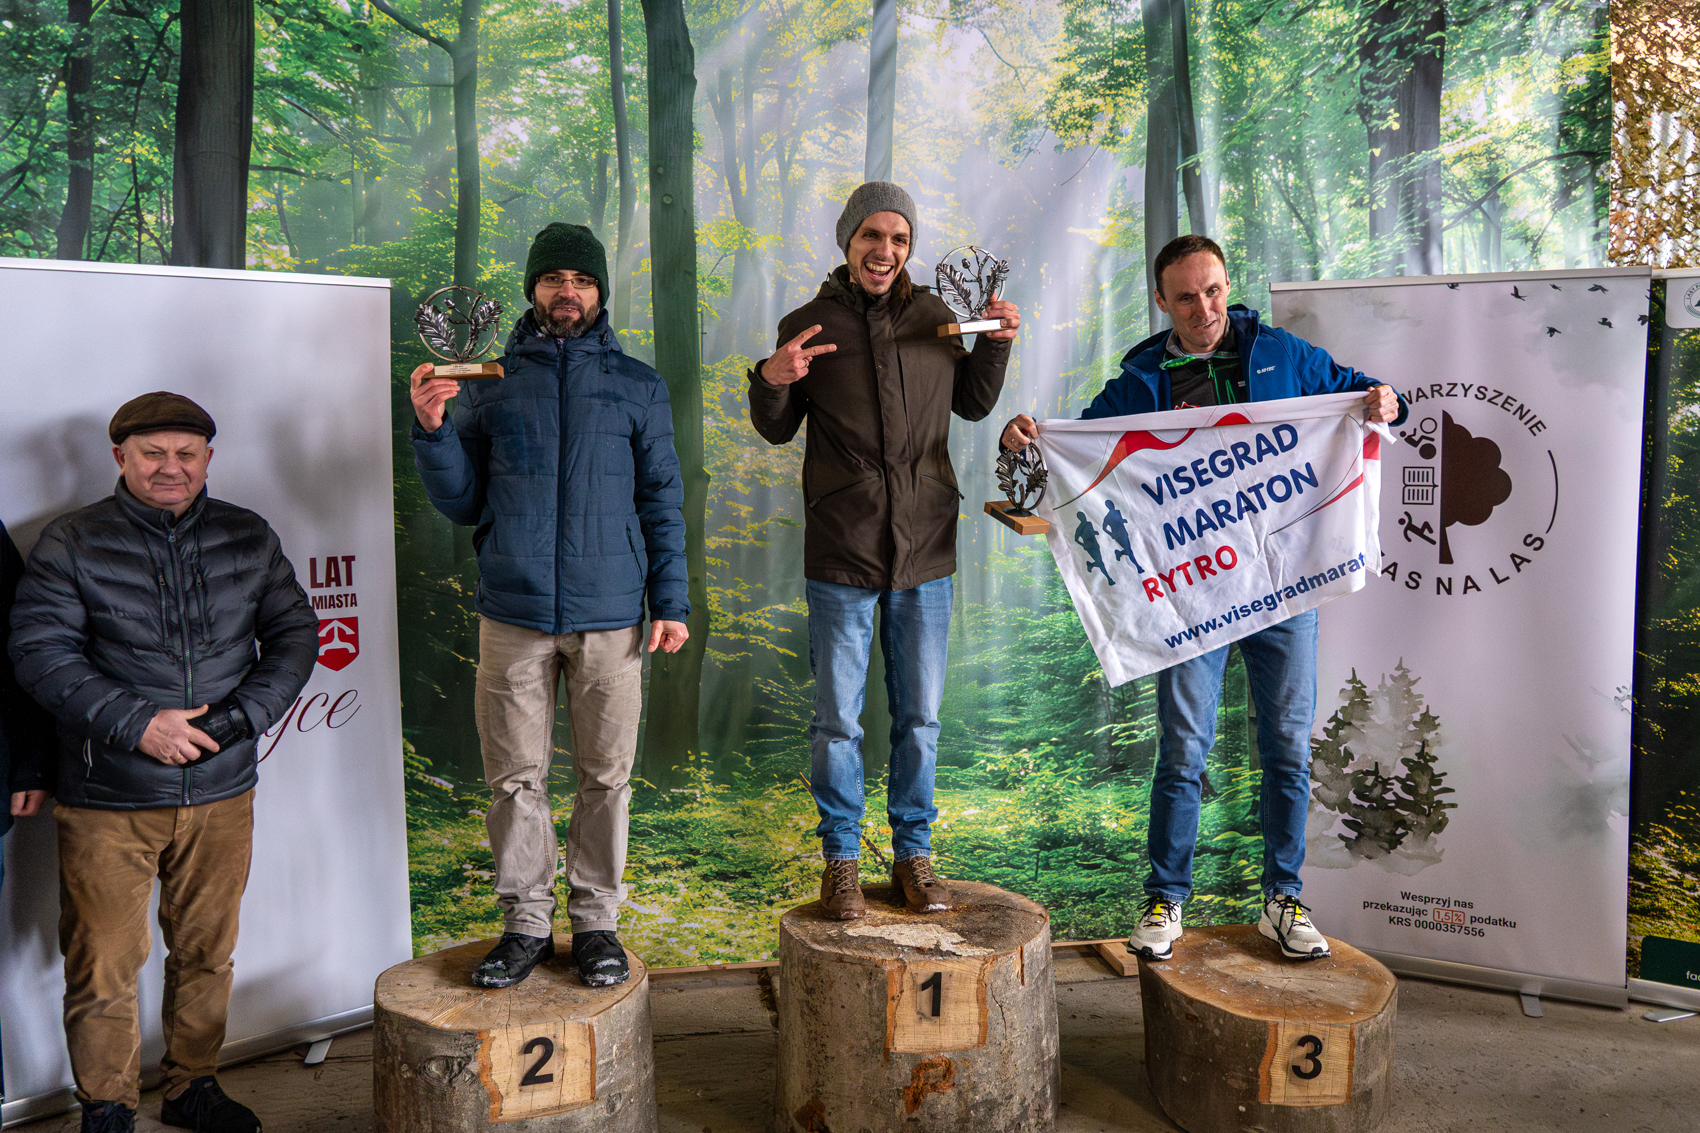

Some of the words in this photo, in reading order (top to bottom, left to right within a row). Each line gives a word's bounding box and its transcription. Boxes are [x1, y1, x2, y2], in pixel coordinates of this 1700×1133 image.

[1141, 423, 1299, 506] VISEGRAD
[1163, 461, 1319, 551] MARATON
[309, 555, 356, 589] LAT
[1142, 545, 1238, 603] RYTRO
[1380, 550, 1422, 590] AS
[1436, 575, 1482, 595] NA
[1488, 533, 1545, 585] LAS
[311, 593, 358, 610] MIASTA
[1363, 900, 1428, 918] przekazując
[1470, 914, 1517, 929] podatku
[1400, 890, 1451, 908] Wesprzyj
[1453, 899, 1474, 909] nas
[1388, 915, 1412, 927] KRS
[1414, 919, 1485, 937] 0000357556
[921, 971, 942, 1017] 1
[520, 1036, 554, 1087] 2
[1291, 1034, 1323, 1080] 3
